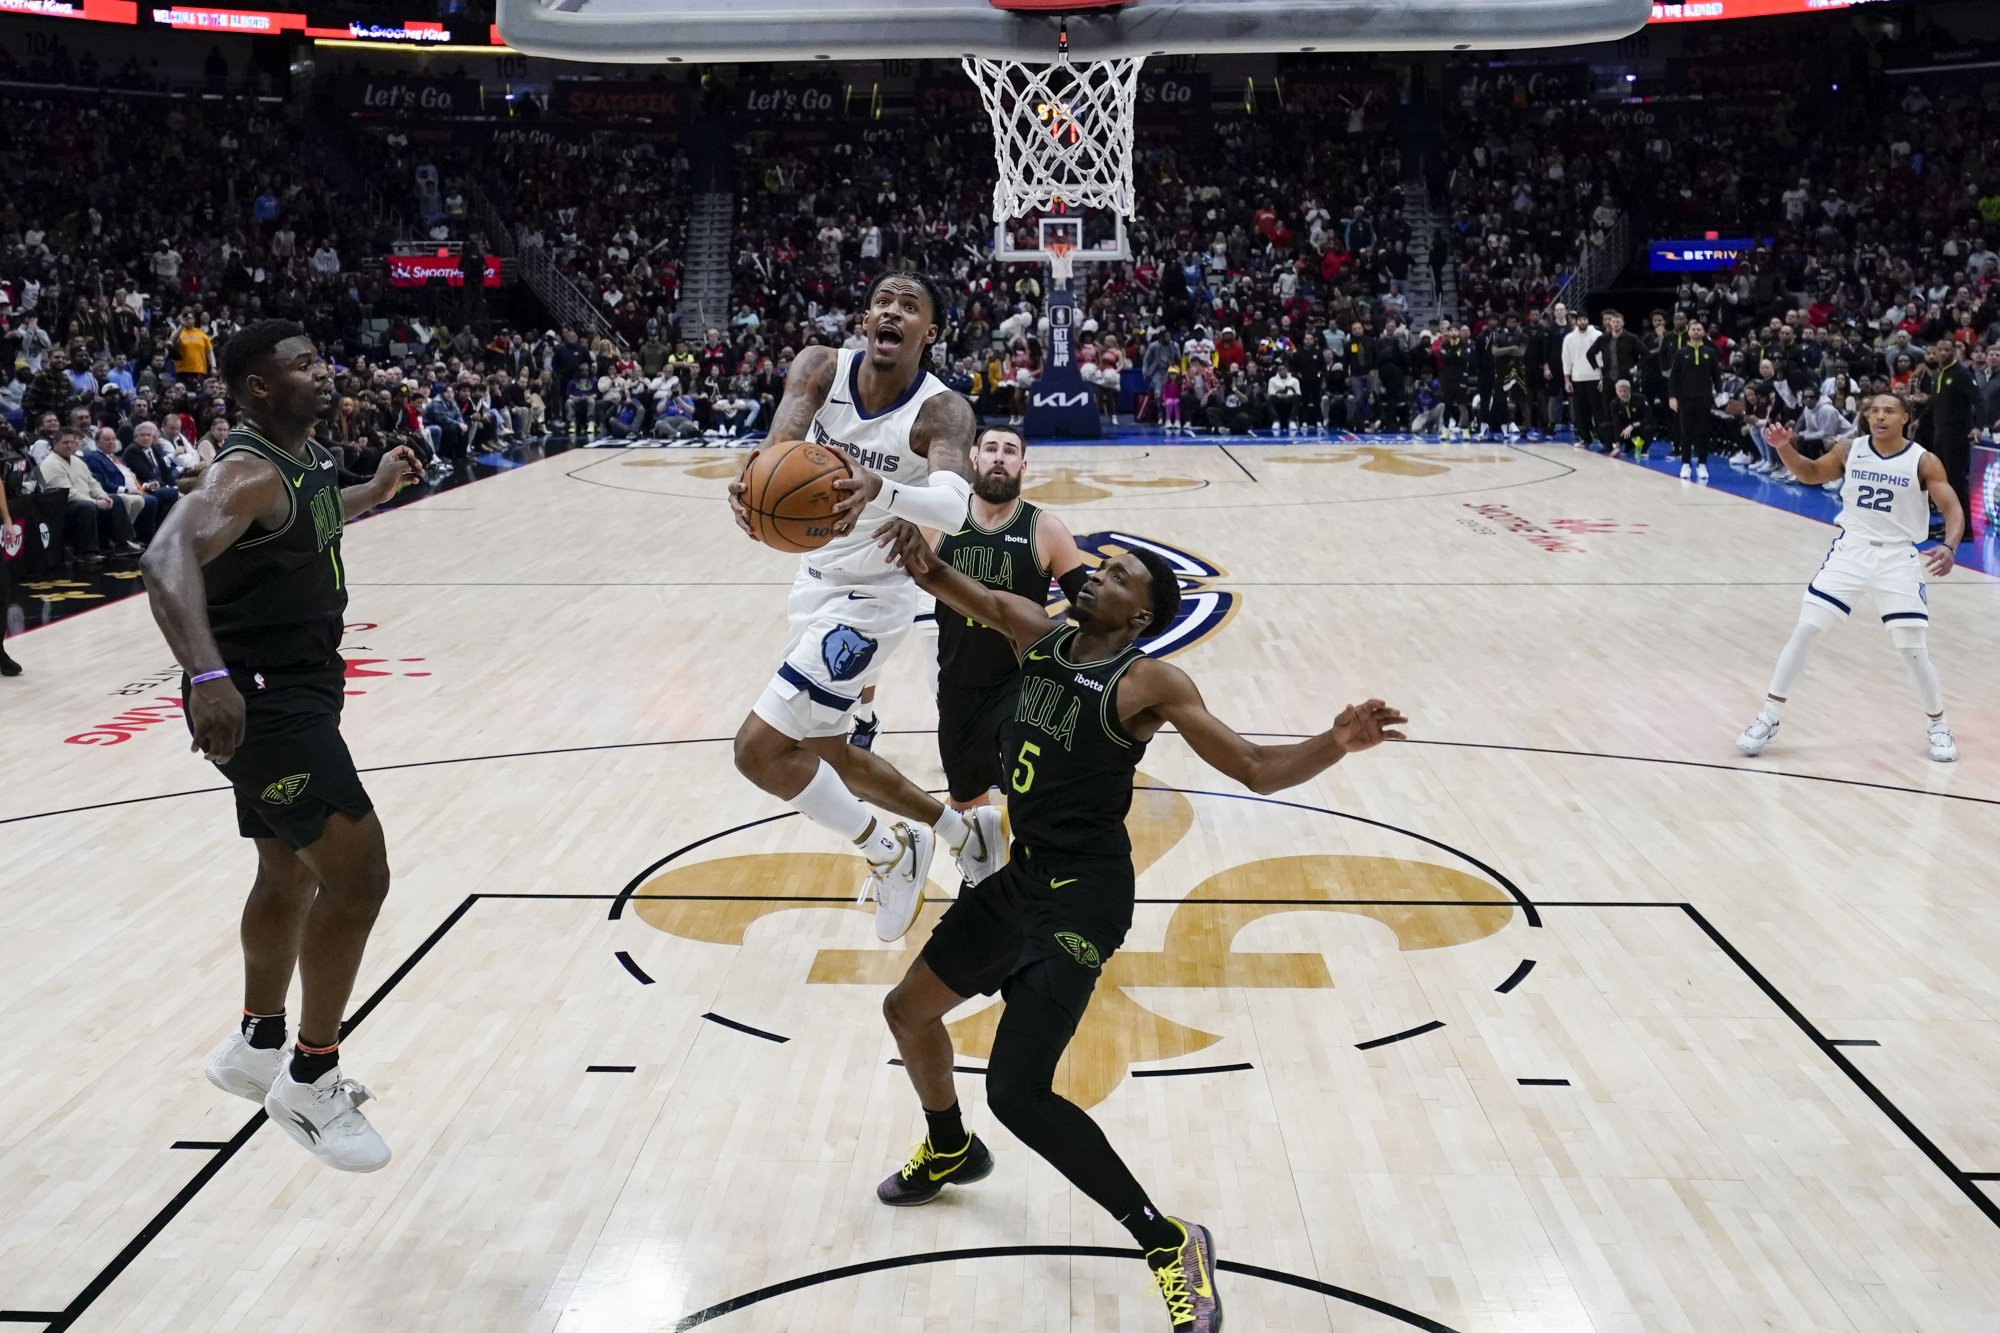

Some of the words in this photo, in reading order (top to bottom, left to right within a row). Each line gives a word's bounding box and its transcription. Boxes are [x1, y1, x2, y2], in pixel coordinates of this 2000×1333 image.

[25, 31, 58, 55] 104
[1617, 37, 1649, 59] 108
[364, 84, 415, 108] Let's
[420, 86, 452, 109] Go
[747, 88, 797, 111] Let's
[802, 88, 833, 111] Go
[1161, 81, 1192, 103] Go
[1632, 110, 1655, 125] Go
[1683, 250, 1739, 261] BETRIV
[1053, 327, 1069, 341] GET
[1053, 340, 1070, 354] THE
[1053, 353, 1070, 367] APP
[1851, 469, 1910, 487] MEMPHIS
[1856, 485, 1894, 513] 22
[1004, 534, 1028, 544] ibotta
[330, 546, 340, 590] 1
[952, 545, 1013, 590] NOLA
[1074, 673, 1104, 692] ibotta
[1015, 674, 1081, 752] NOLA
[1011, 740, 1041, 794] 5
